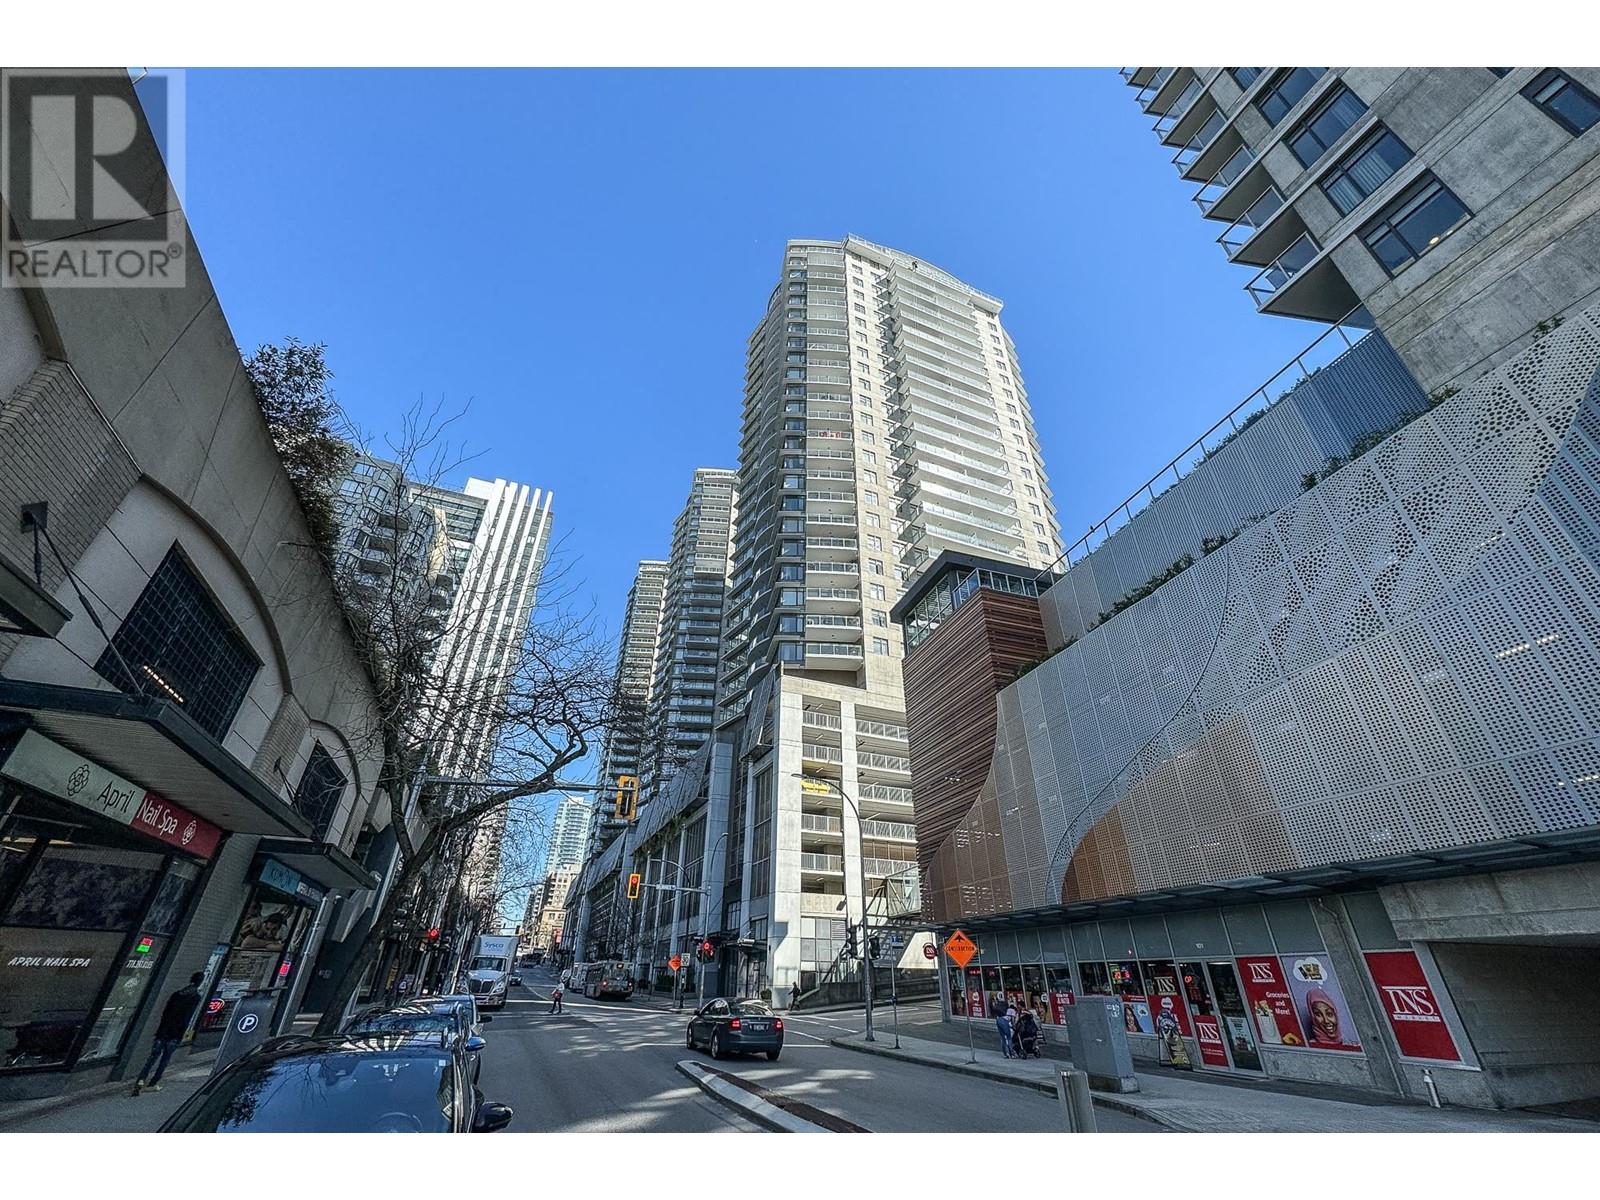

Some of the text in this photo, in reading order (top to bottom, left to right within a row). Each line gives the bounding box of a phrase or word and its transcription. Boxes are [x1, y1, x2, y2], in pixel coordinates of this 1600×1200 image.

[97, 781, 136, 814] April
[137, 798, 178, 836] Nail Spa
[484, 942, 504, 950] Sysco
[8, 957, 91, 968] APRIL NAIL SPA
[1249, 965, 1274, 979] INS
[1265, 991, 1290, 999] Groceries
[1275, 1008, 1291, 1016] More!
